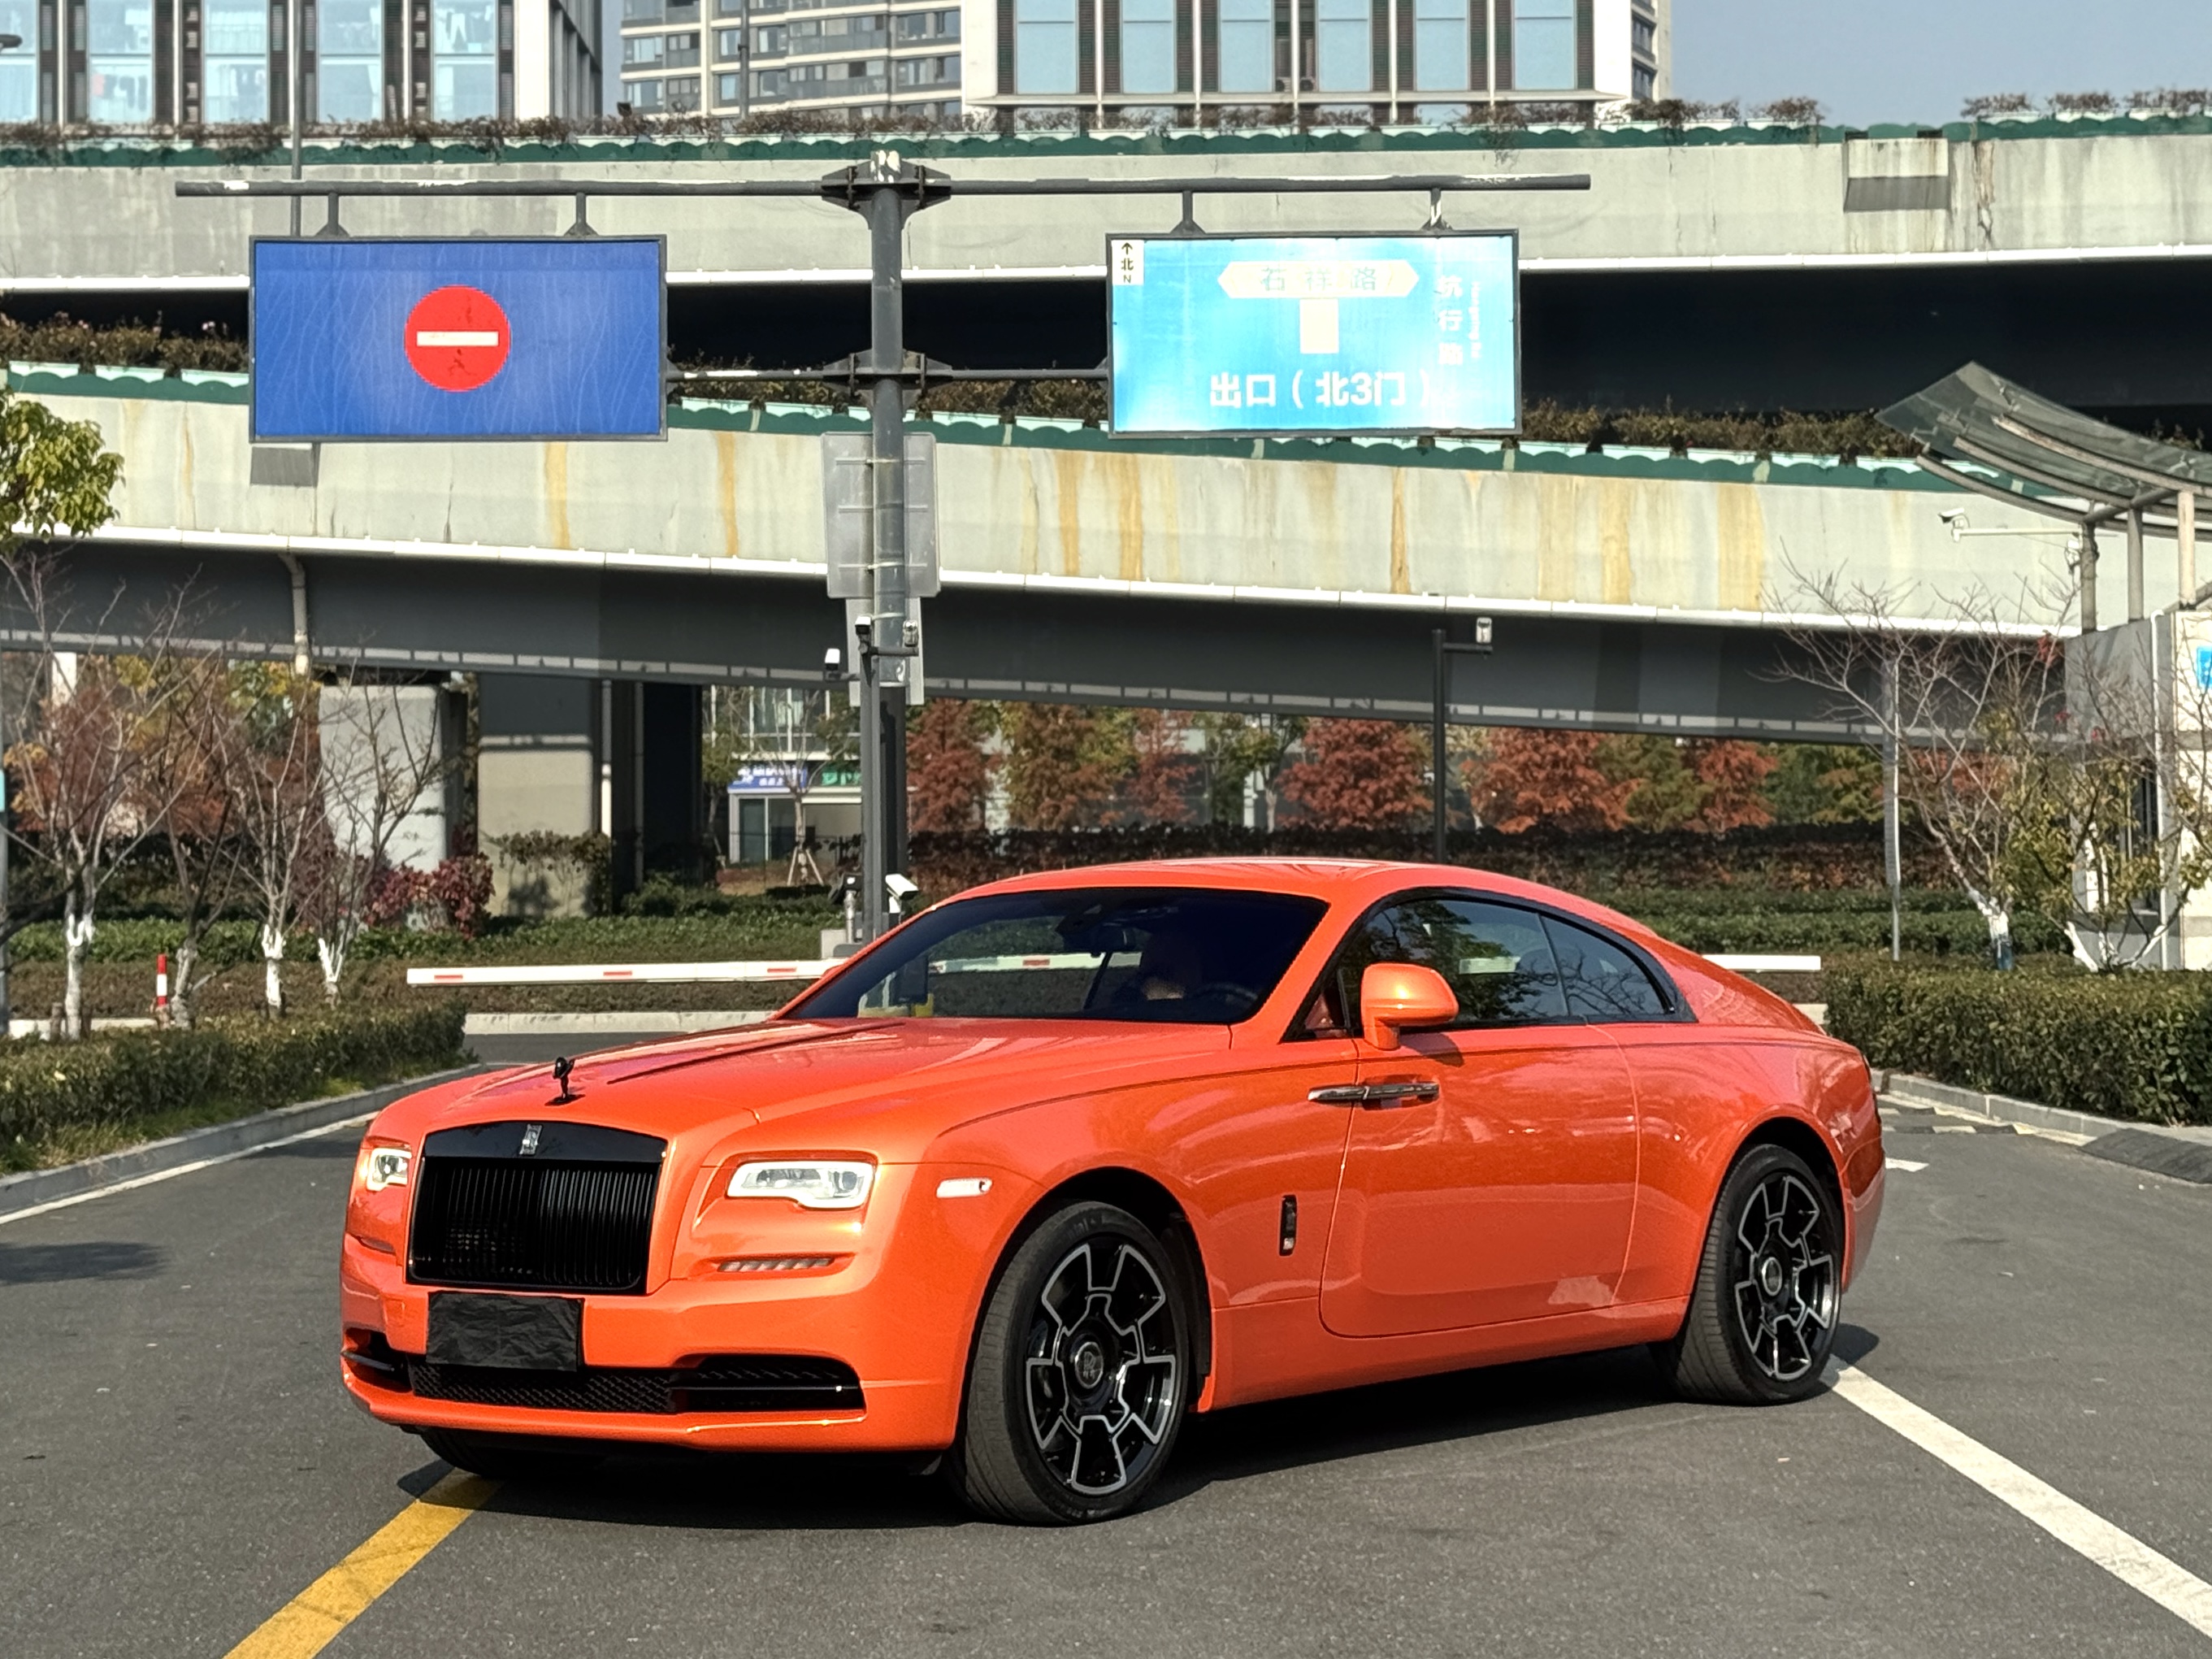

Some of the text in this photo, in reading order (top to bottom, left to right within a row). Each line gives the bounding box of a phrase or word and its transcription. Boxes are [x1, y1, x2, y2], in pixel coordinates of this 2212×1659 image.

[1121, 258, 1134, 271] 北
[1123, 275, 1131, 284] N
[1260, 267, 1377, 291] 石祥路
